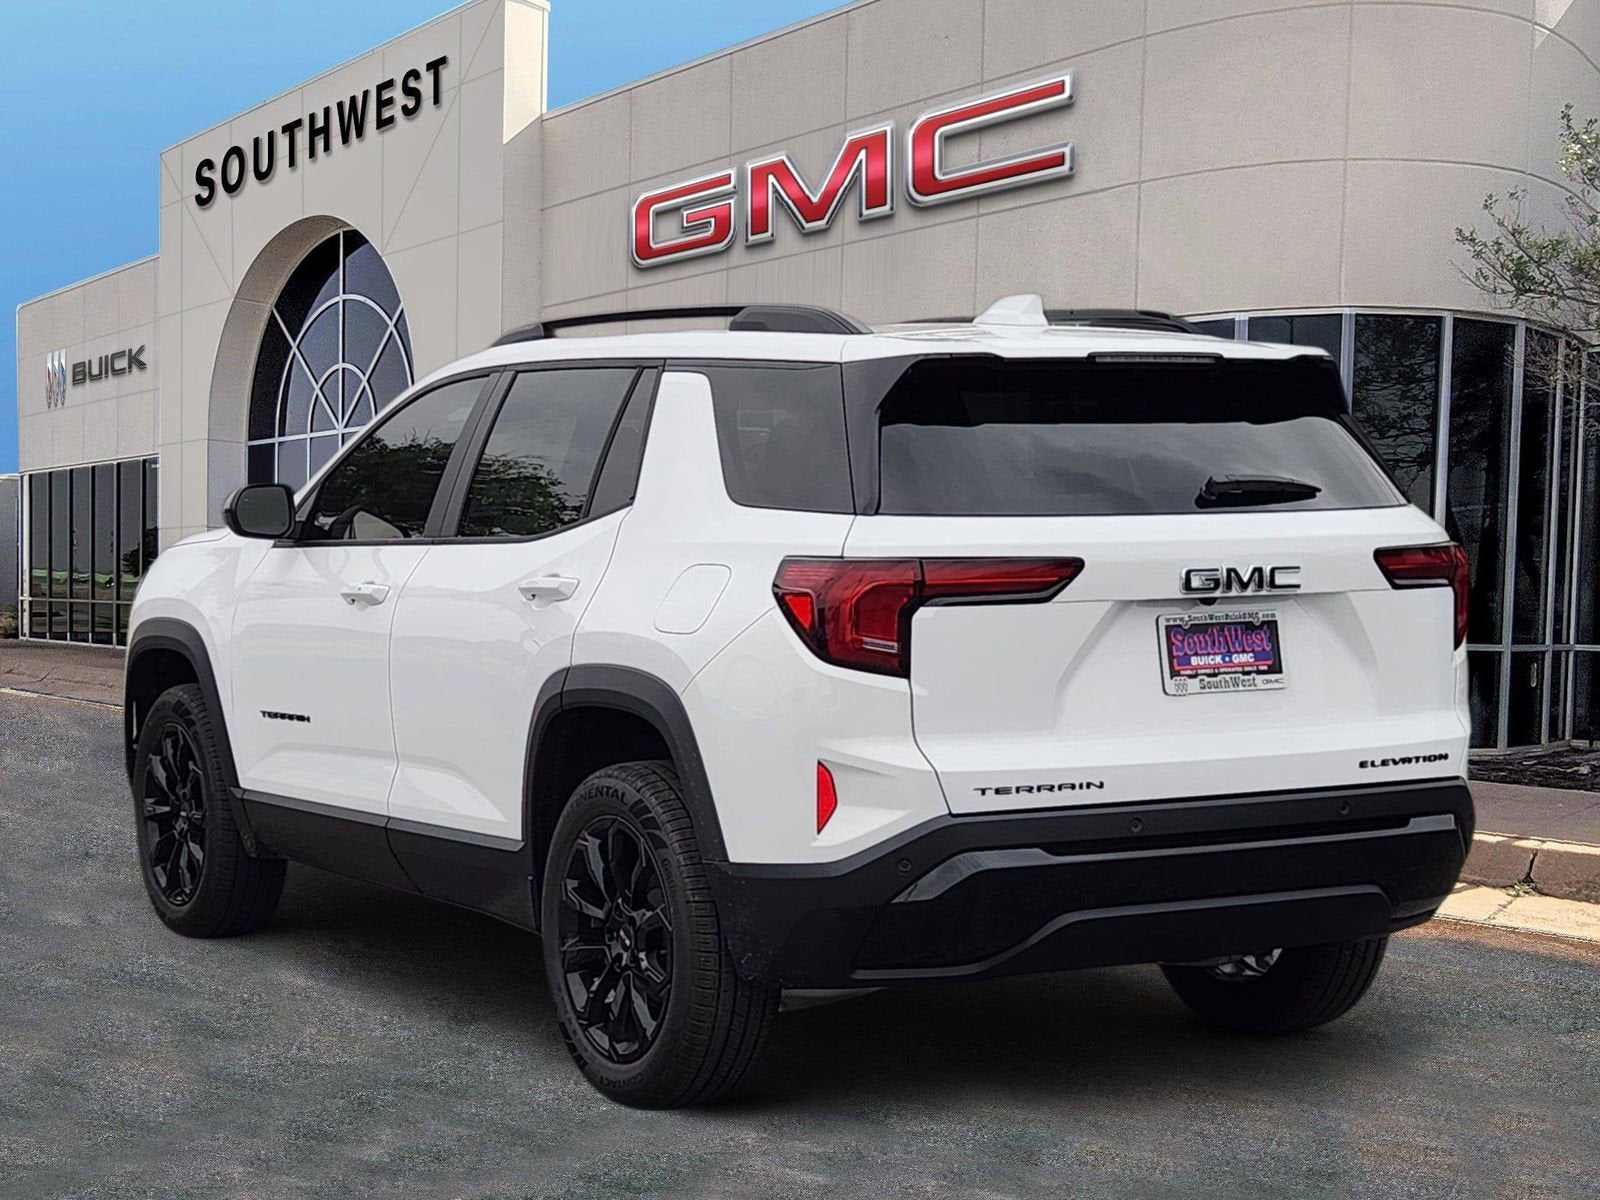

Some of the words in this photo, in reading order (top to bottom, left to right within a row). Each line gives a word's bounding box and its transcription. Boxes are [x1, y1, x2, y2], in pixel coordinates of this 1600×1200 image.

[194, 55, 449, 208] SOUTHWEST
[630, 69, 1077, 269] GMC
[71, 345, 147, 386] BUICK
[1180, 565, 1301, 595] GMC
[1171, 624, 1272, 656] SouthWest
[1191, 654, 1223, 665] BUICK
[1232, 653, 1254, 663] GMC
[1199, 676, 1258, 691] SouthWest
[260, 709, 311, 723] TERRAIN
[1358, 752, 1450, 769] ELEVATION
[972, 780, 1104, 797] TERRAIN
